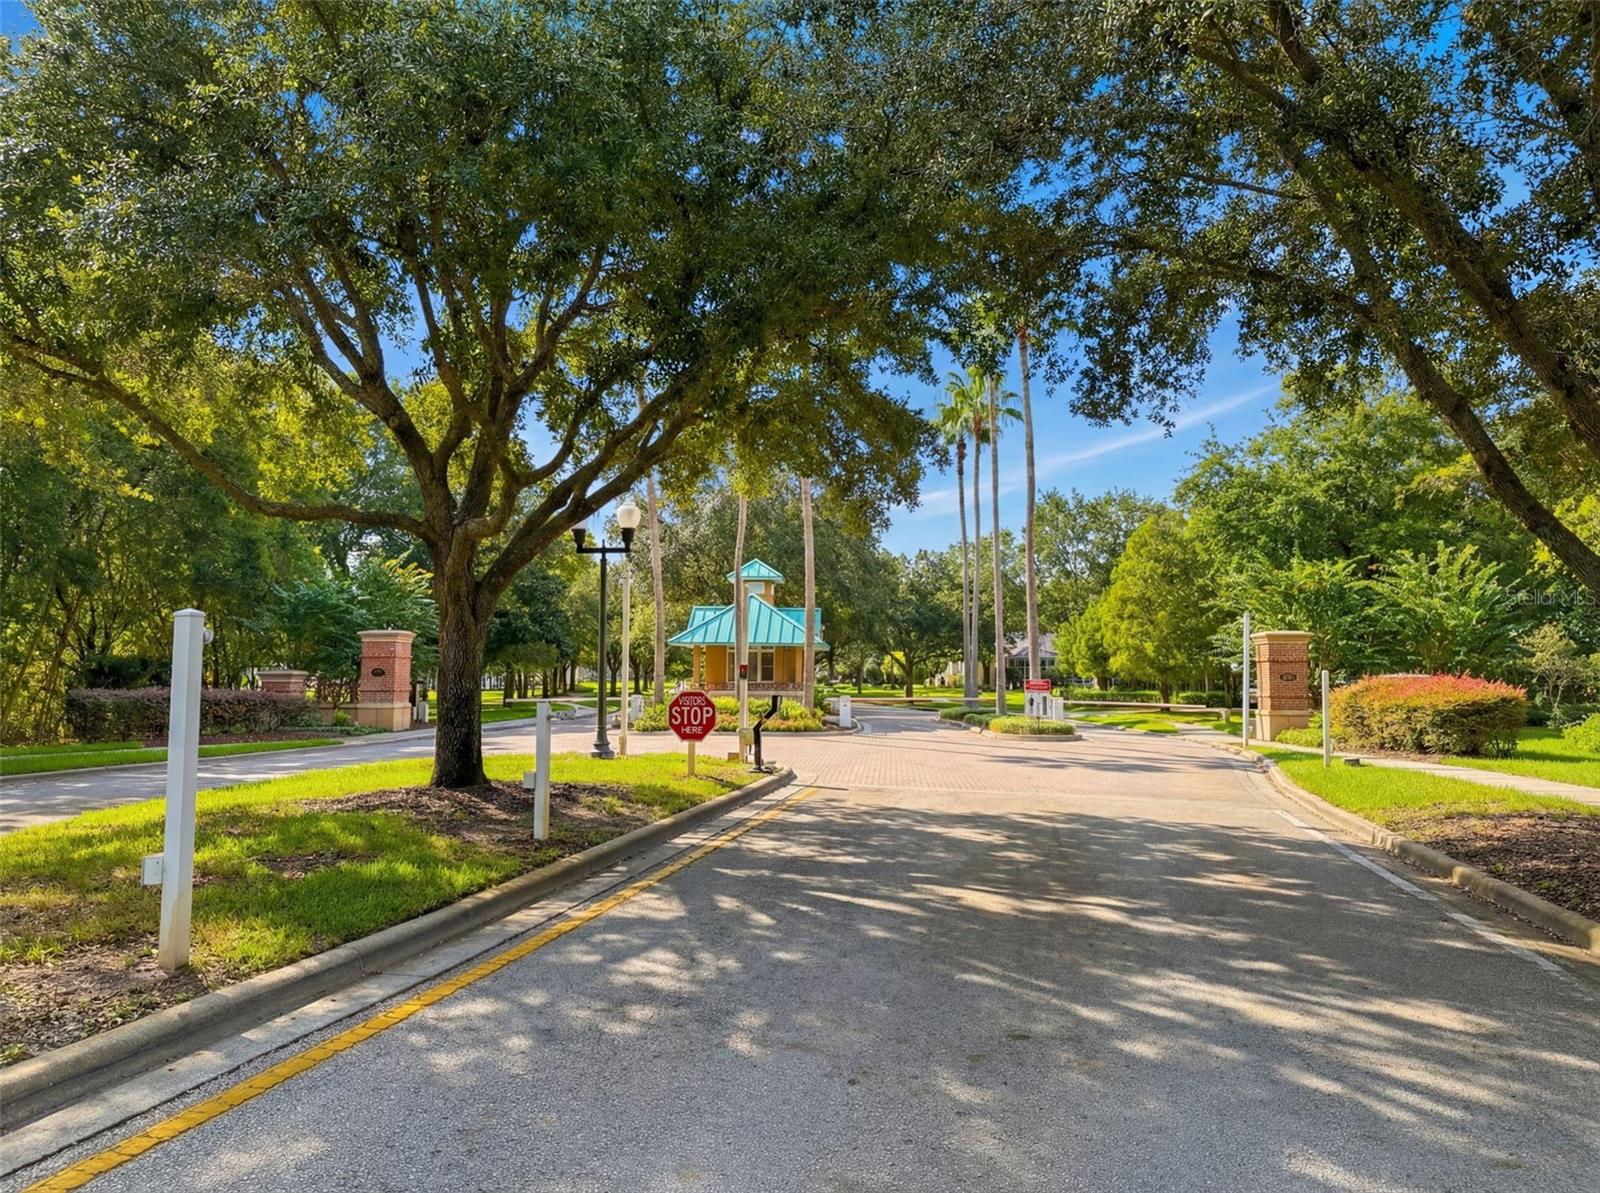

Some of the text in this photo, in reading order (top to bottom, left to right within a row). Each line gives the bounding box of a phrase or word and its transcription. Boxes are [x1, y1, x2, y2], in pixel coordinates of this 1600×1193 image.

[678, 696, 707, 706] VISITORS
[671, 706, 713, 725] STOP
[681, 726, 704, 734] HERE
